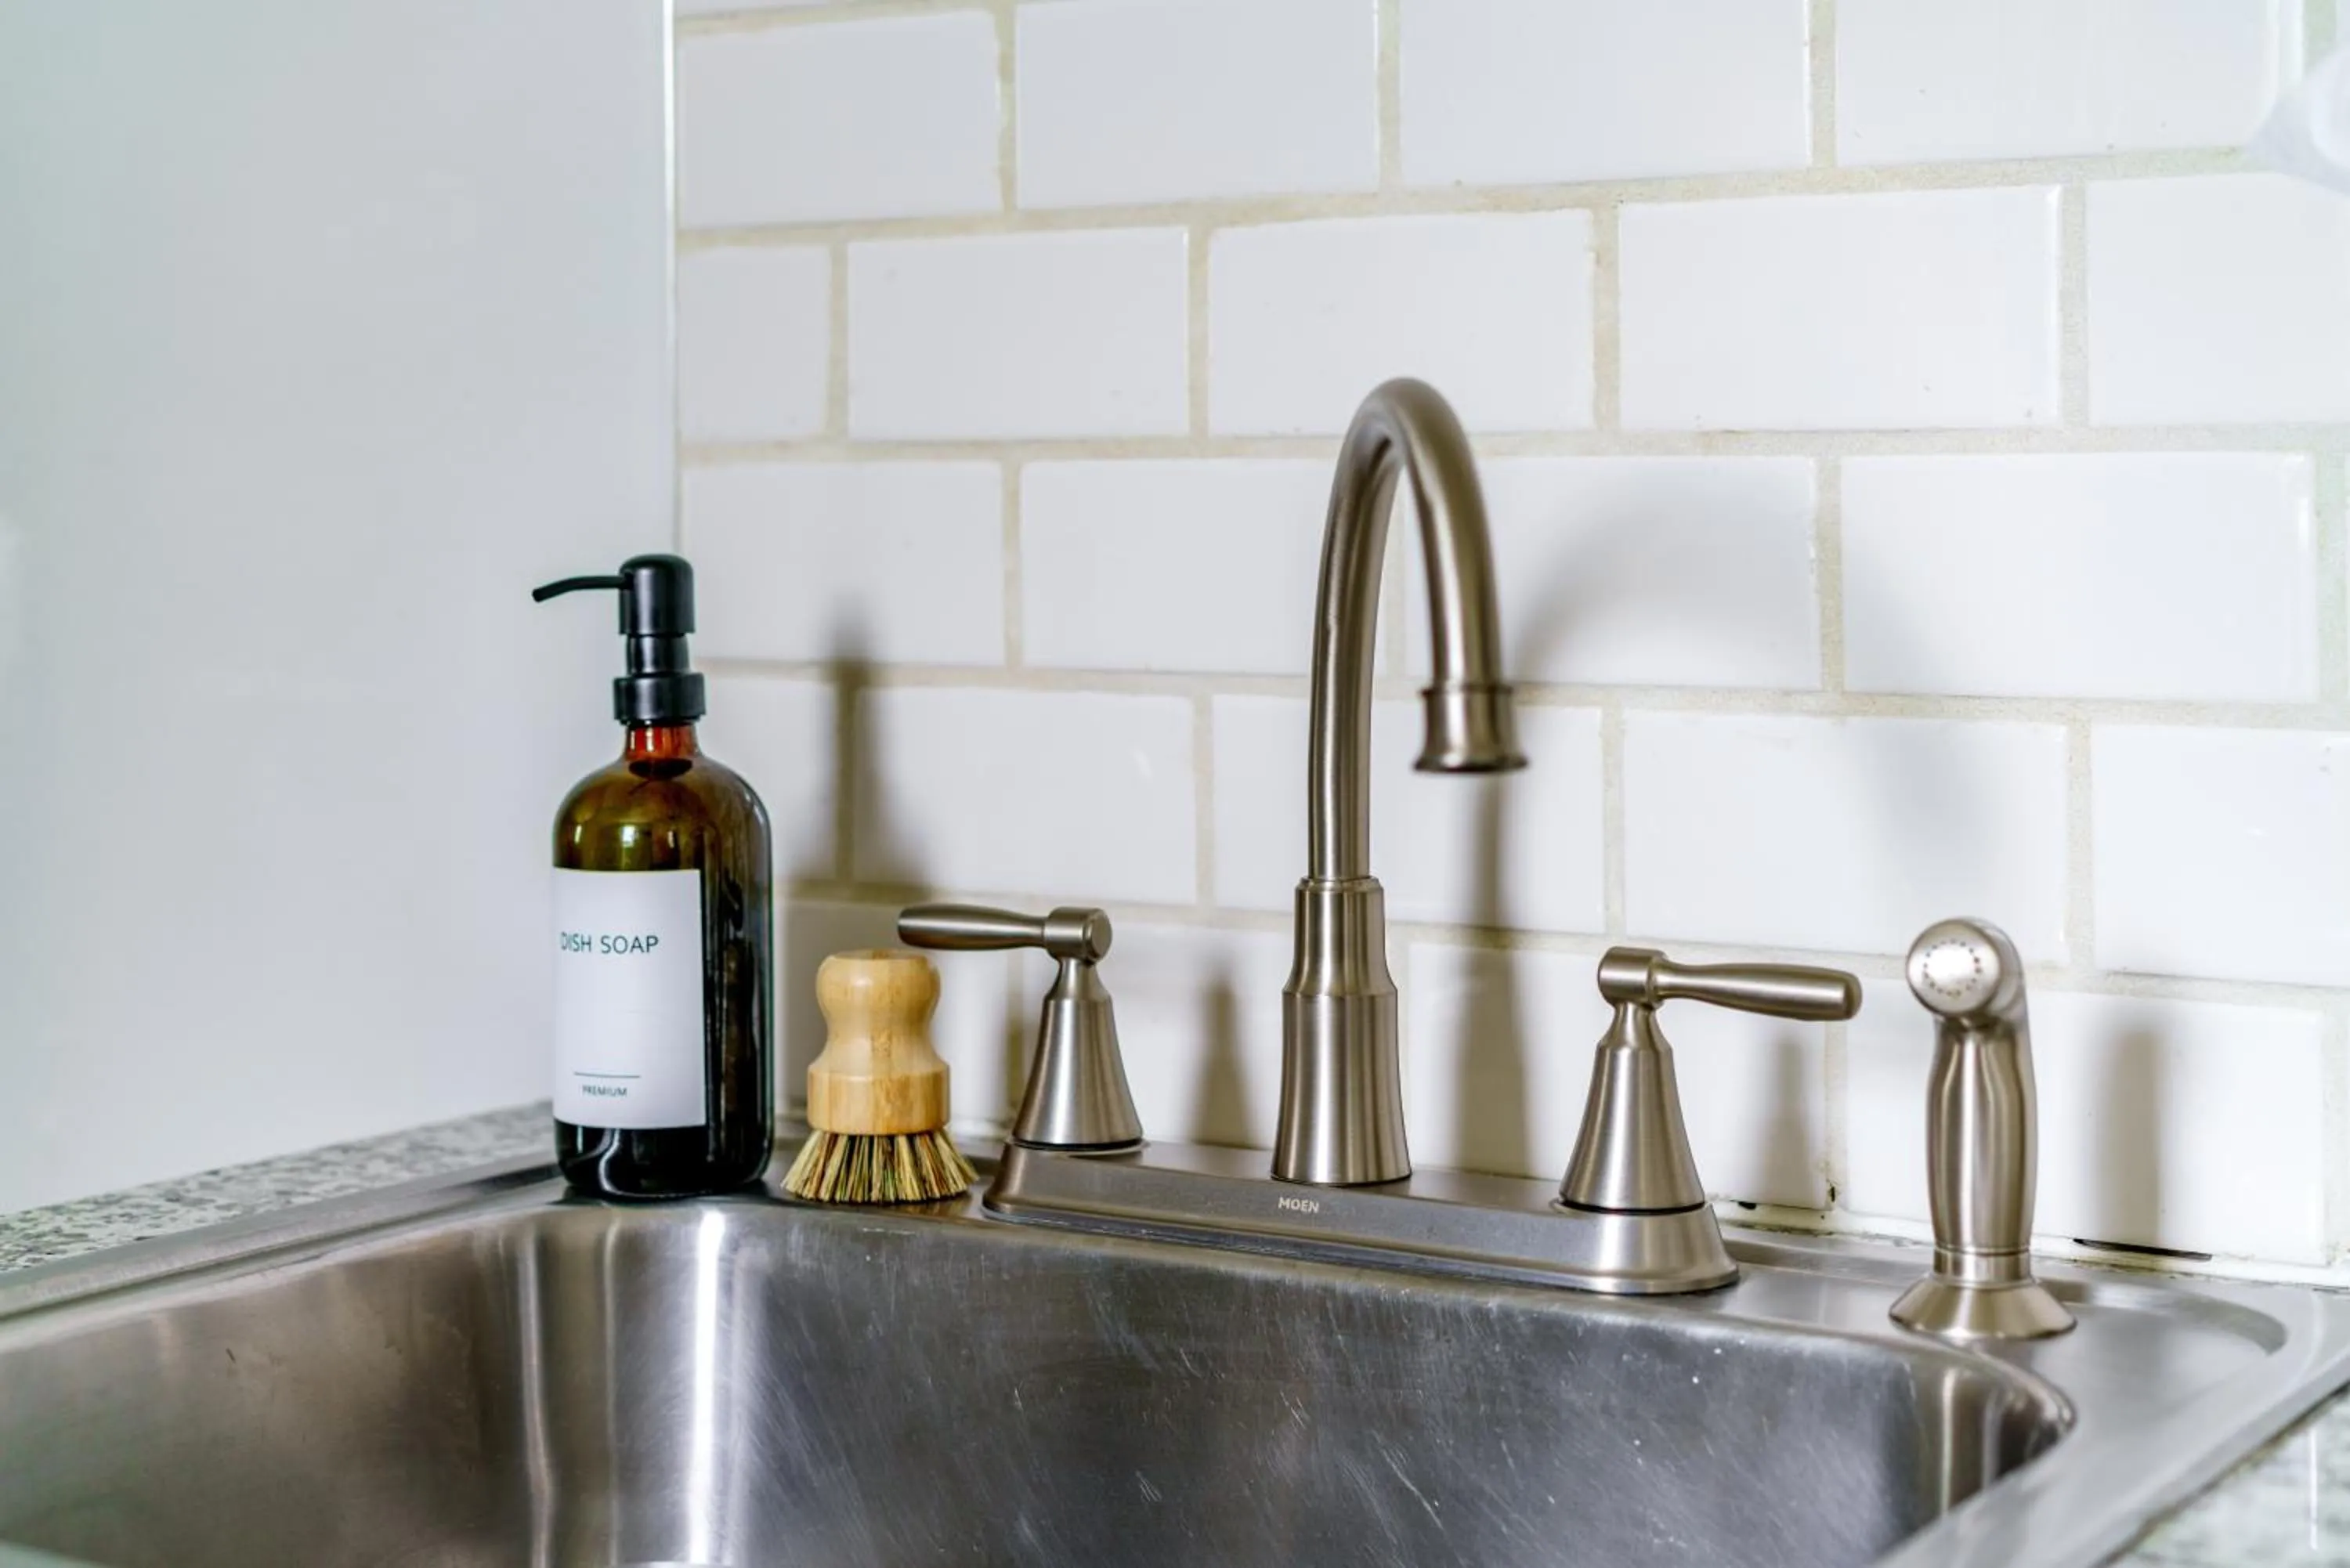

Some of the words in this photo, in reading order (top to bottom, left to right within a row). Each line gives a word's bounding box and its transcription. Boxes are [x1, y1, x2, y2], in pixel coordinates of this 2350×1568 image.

[560, 931, 592, 952] DISH
[600, 935, 659, 954] SOAP
[582, 1084, 627, 1097] PREMIUM
[1278, 1196, 1319, 1213] MOEN
